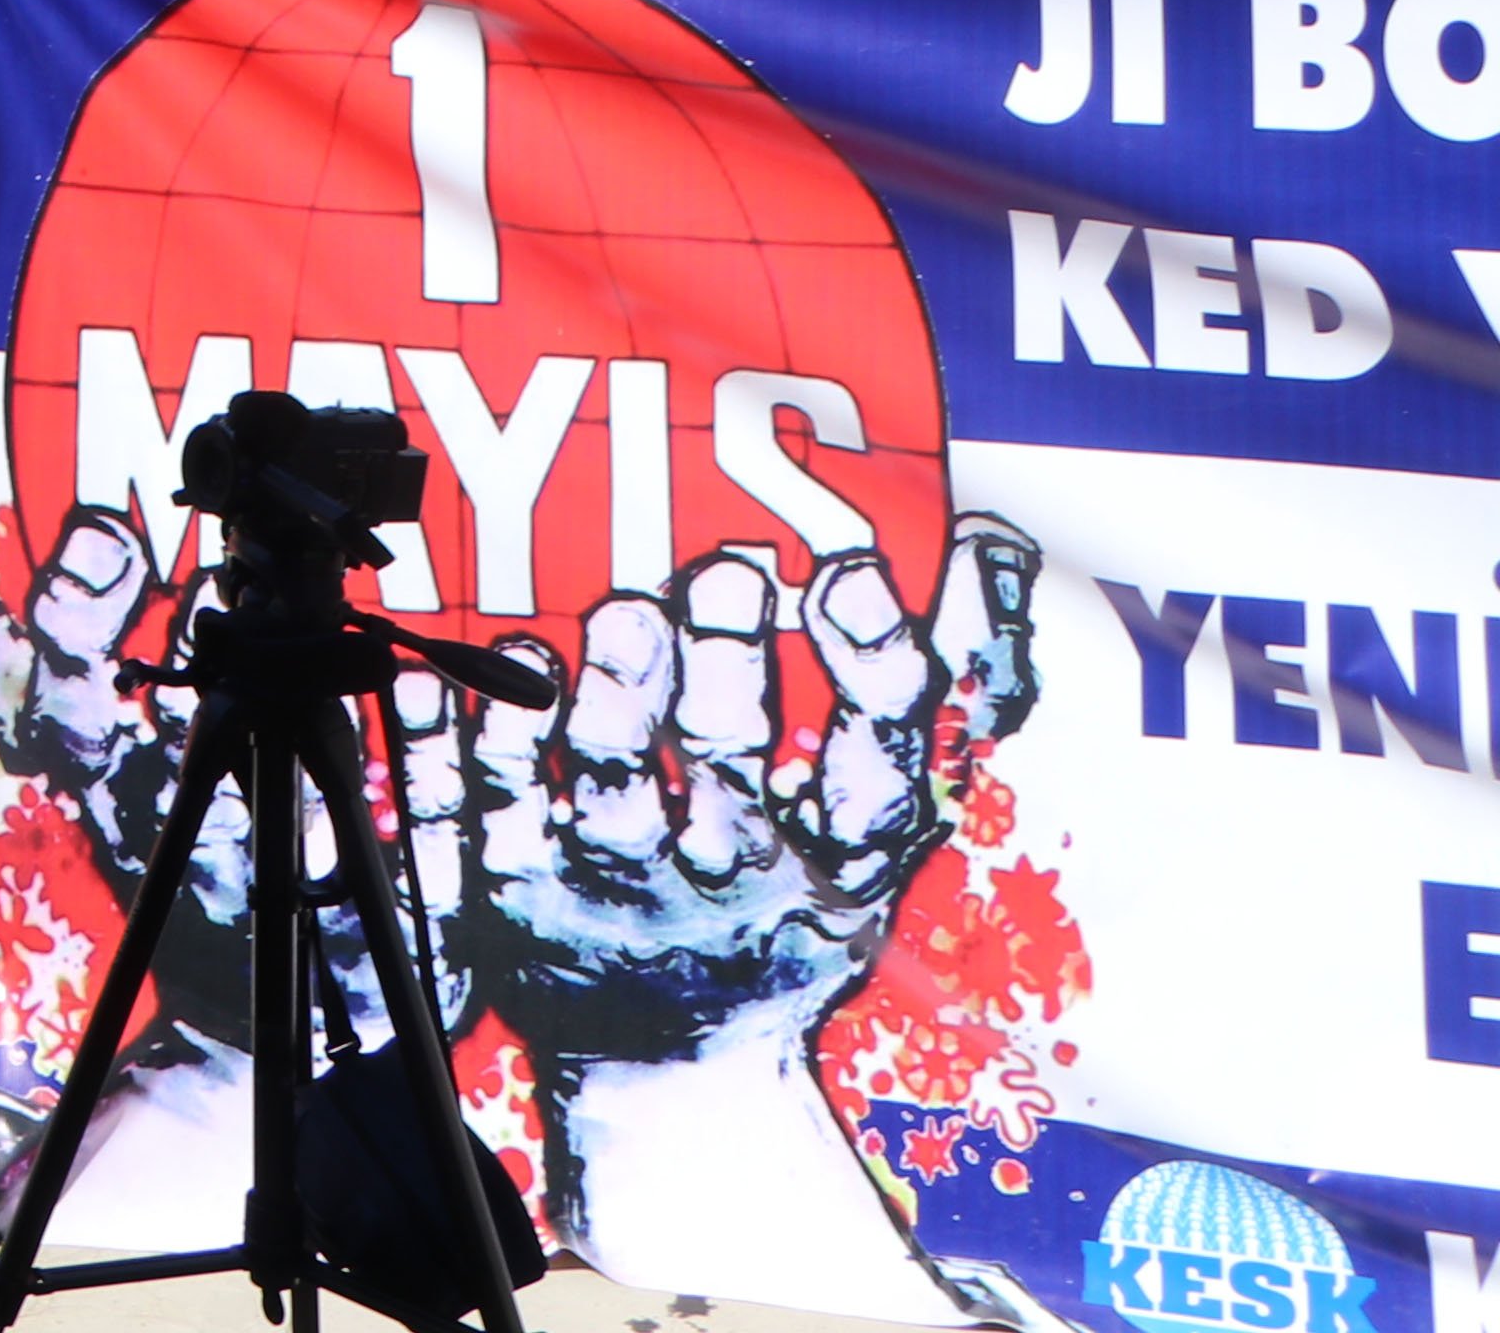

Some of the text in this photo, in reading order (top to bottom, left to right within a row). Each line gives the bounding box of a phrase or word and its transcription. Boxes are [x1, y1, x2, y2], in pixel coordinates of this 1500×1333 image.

[388, 2, 502, 305] 1
[1007, 208, 1395, 381] KED
[1080, 1238, 1377, 1333] KESK
